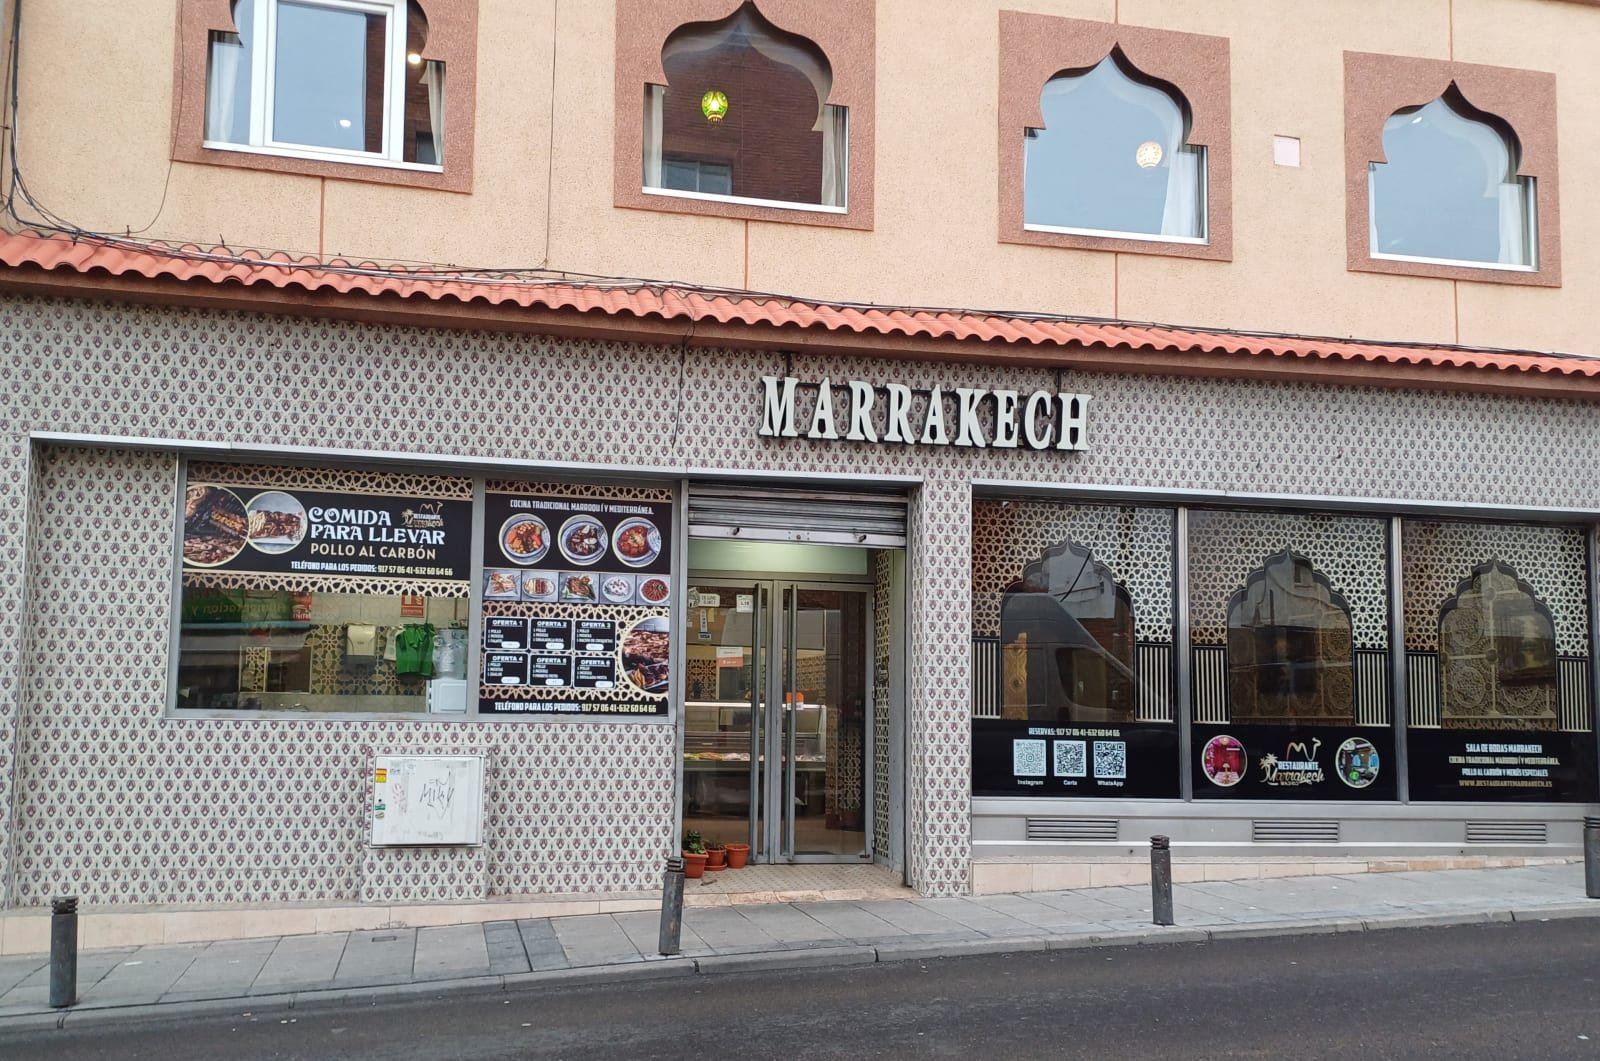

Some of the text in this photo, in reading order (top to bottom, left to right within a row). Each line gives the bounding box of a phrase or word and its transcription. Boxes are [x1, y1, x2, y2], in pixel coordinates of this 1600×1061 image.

[758, 375, 1094, 451] MARRAKECH
[510, 500, 531, 508] COCINA
[532, 500, 570, 510] TRADICIONAL
[308, 506, 391, 526] COMIDA
[311, 524, 446, 545] PARA LLEVAR
[310, 543, 436, 560] POLLO AL CARBÓN
[291, 560, 320, 570] TELÉFONO
[321, 562, 337, 571] PARA
[338, 563, 350, 572] LOS
[378, 565, 388, 573] 917
[495, 701, 523, 711] TELÉFONO
[525, 702, 541, 711] PARA
[542, 703, 553, 711] LOS
[554, 703, 580, 712] PEDIDOS:
[582, 703, 592, 712] 917
[592, 704, 600, 712] 57
[610, 704, 630, 712] 41-632
[630, 704, 639, 712] 60
[1466, 743, 1480, 752] SALA
[1481, 744, 1488, 752] DE
[1278, 761, 1319, 770] RESTAURANTE
[1260, 768, 1325, 784] Marrakech
